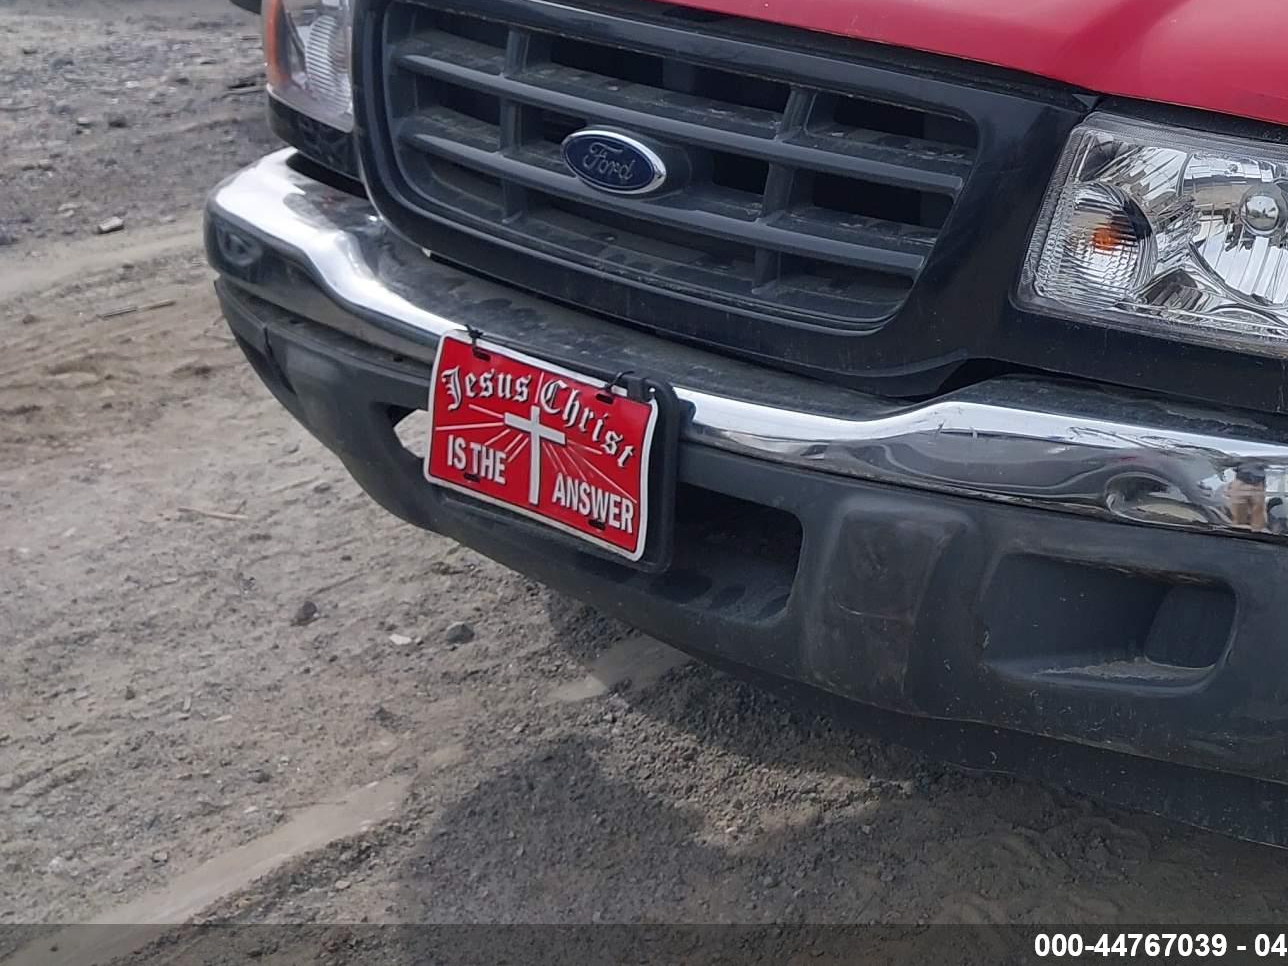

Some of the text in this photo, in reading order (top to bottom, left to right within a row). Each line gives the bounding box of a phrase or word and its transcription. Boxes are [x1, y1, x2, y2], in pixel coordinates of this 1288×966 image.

[583, 141, 636, 181] Ford
[441, 365, 634, 468] Jesus Christ
[446, 434, 634, 534] IS THE ANSWER
